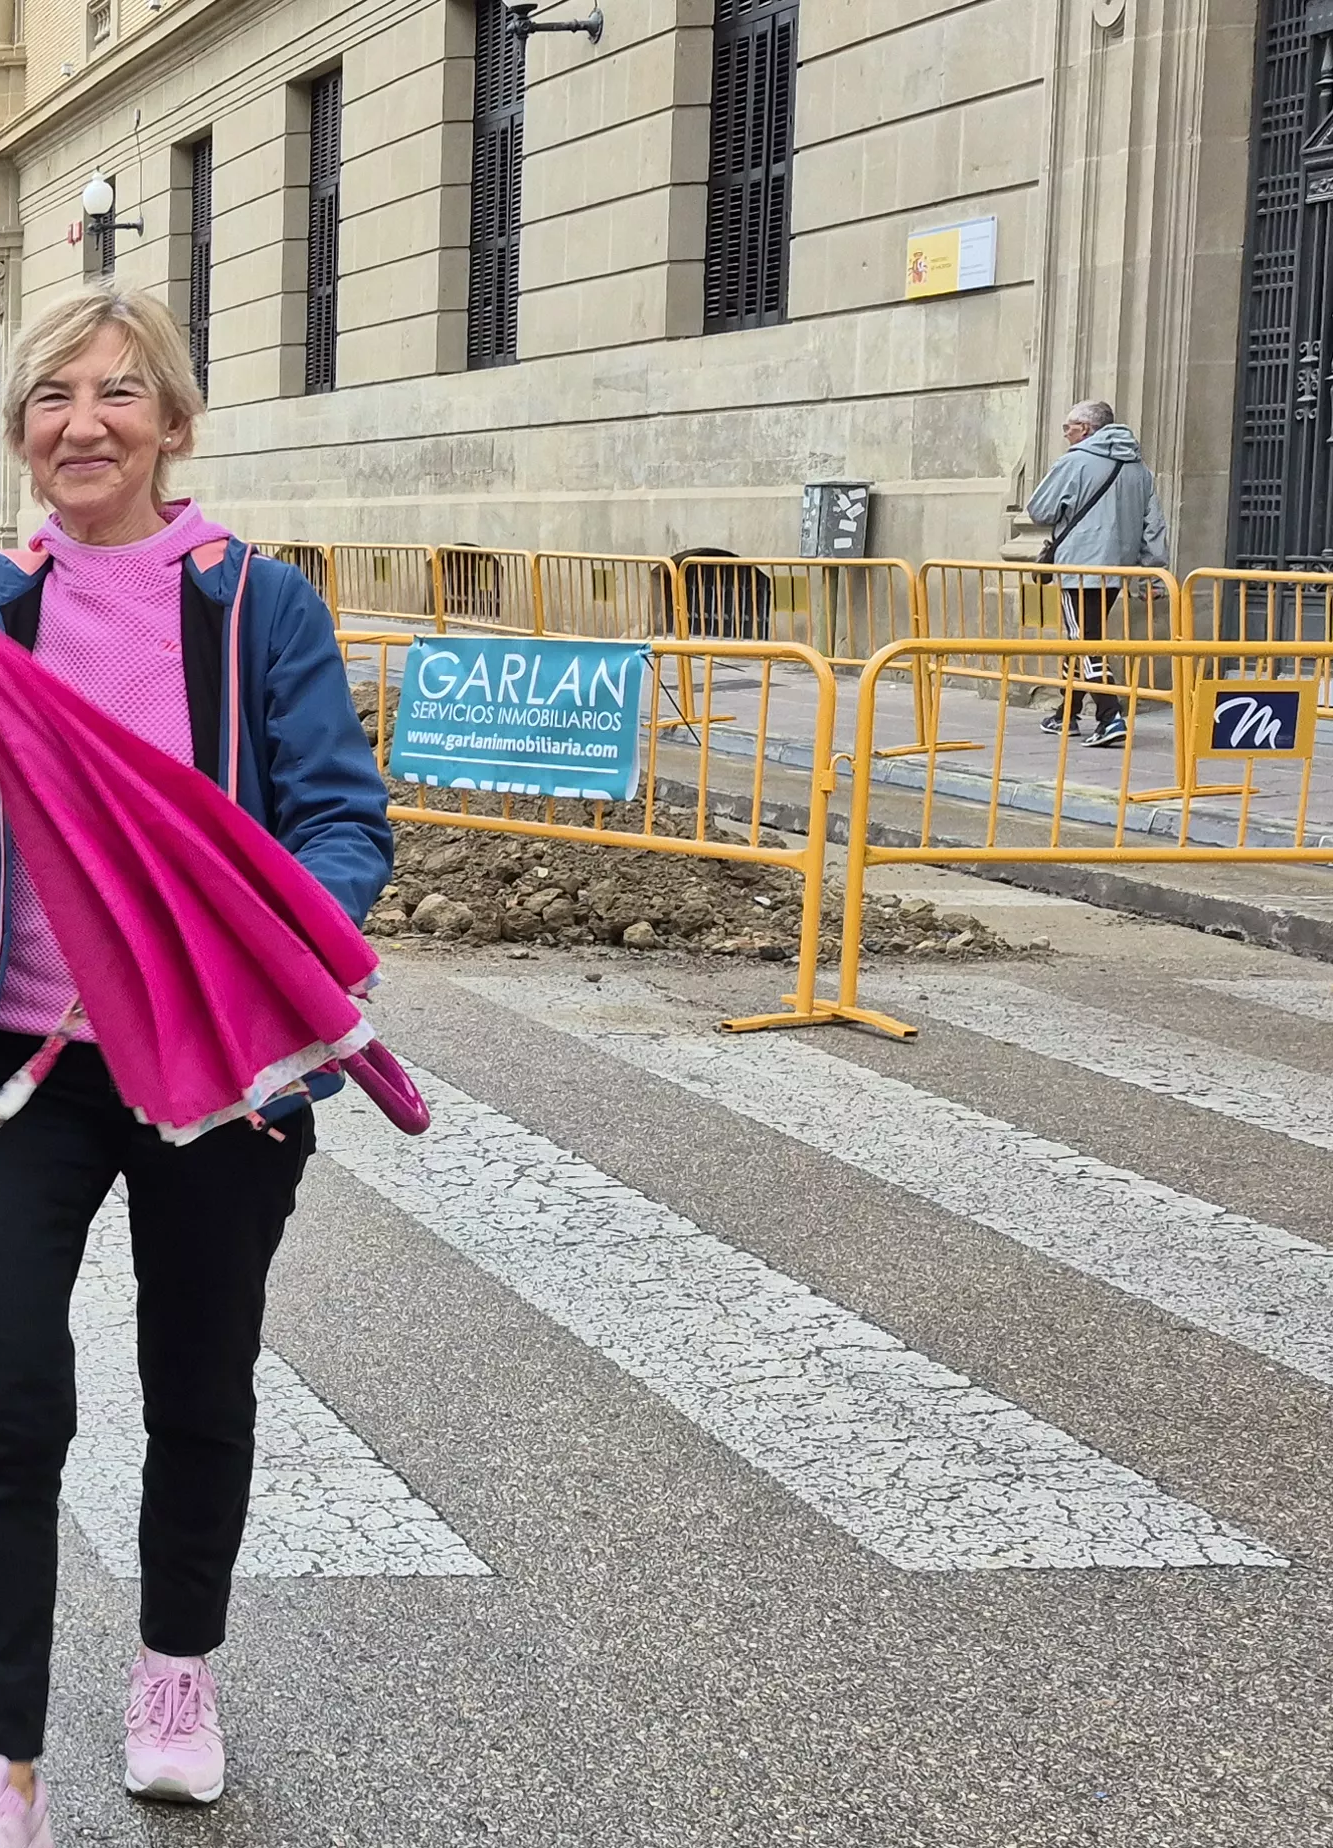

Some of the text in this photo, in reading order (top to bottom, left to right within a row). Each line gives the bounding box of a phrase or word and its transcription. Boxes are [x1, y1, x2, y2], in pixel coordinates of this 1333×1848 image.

[417, 650, 630, 709] GARLAN
[411, 700, 622, 732] SERVICIOS INMOBILIARIOS
[407, 728, 618, 758] www.garlaninmobiliaria.com
